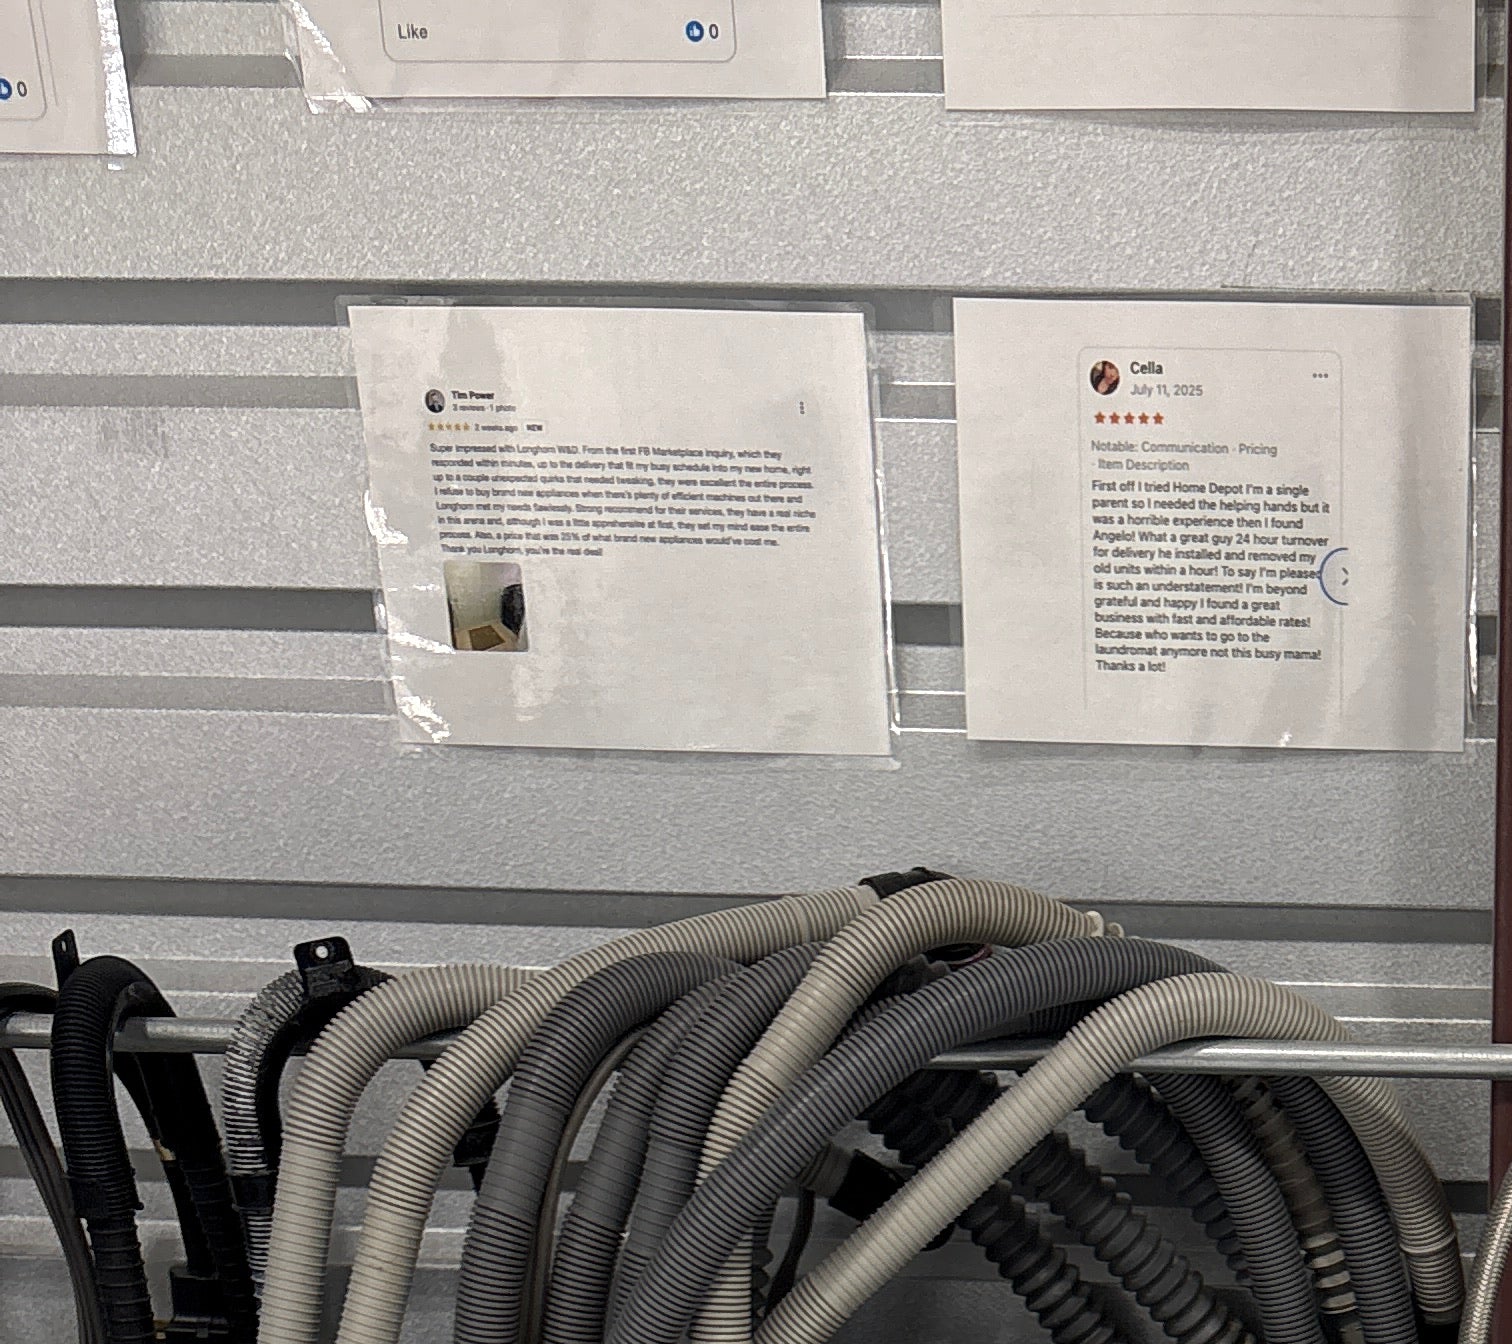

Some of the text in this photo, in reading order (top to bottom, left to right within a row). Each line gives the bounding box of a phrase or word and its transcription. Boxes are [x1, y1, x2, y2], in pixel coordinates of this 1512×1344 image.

[397, 23, 428, 40] Like
[708, 23, 719, 40] 0
[16, 80, 28, 98] 0
[1130, 383, 1204, 398] July 11, 2025
[1090, 439, 1278, 459] Notable: Communication Pricing
[1097, 457, 1190, 473] Item Description
[1091, 479, 1310, 499] First off I tried Home Depot I'm a single
